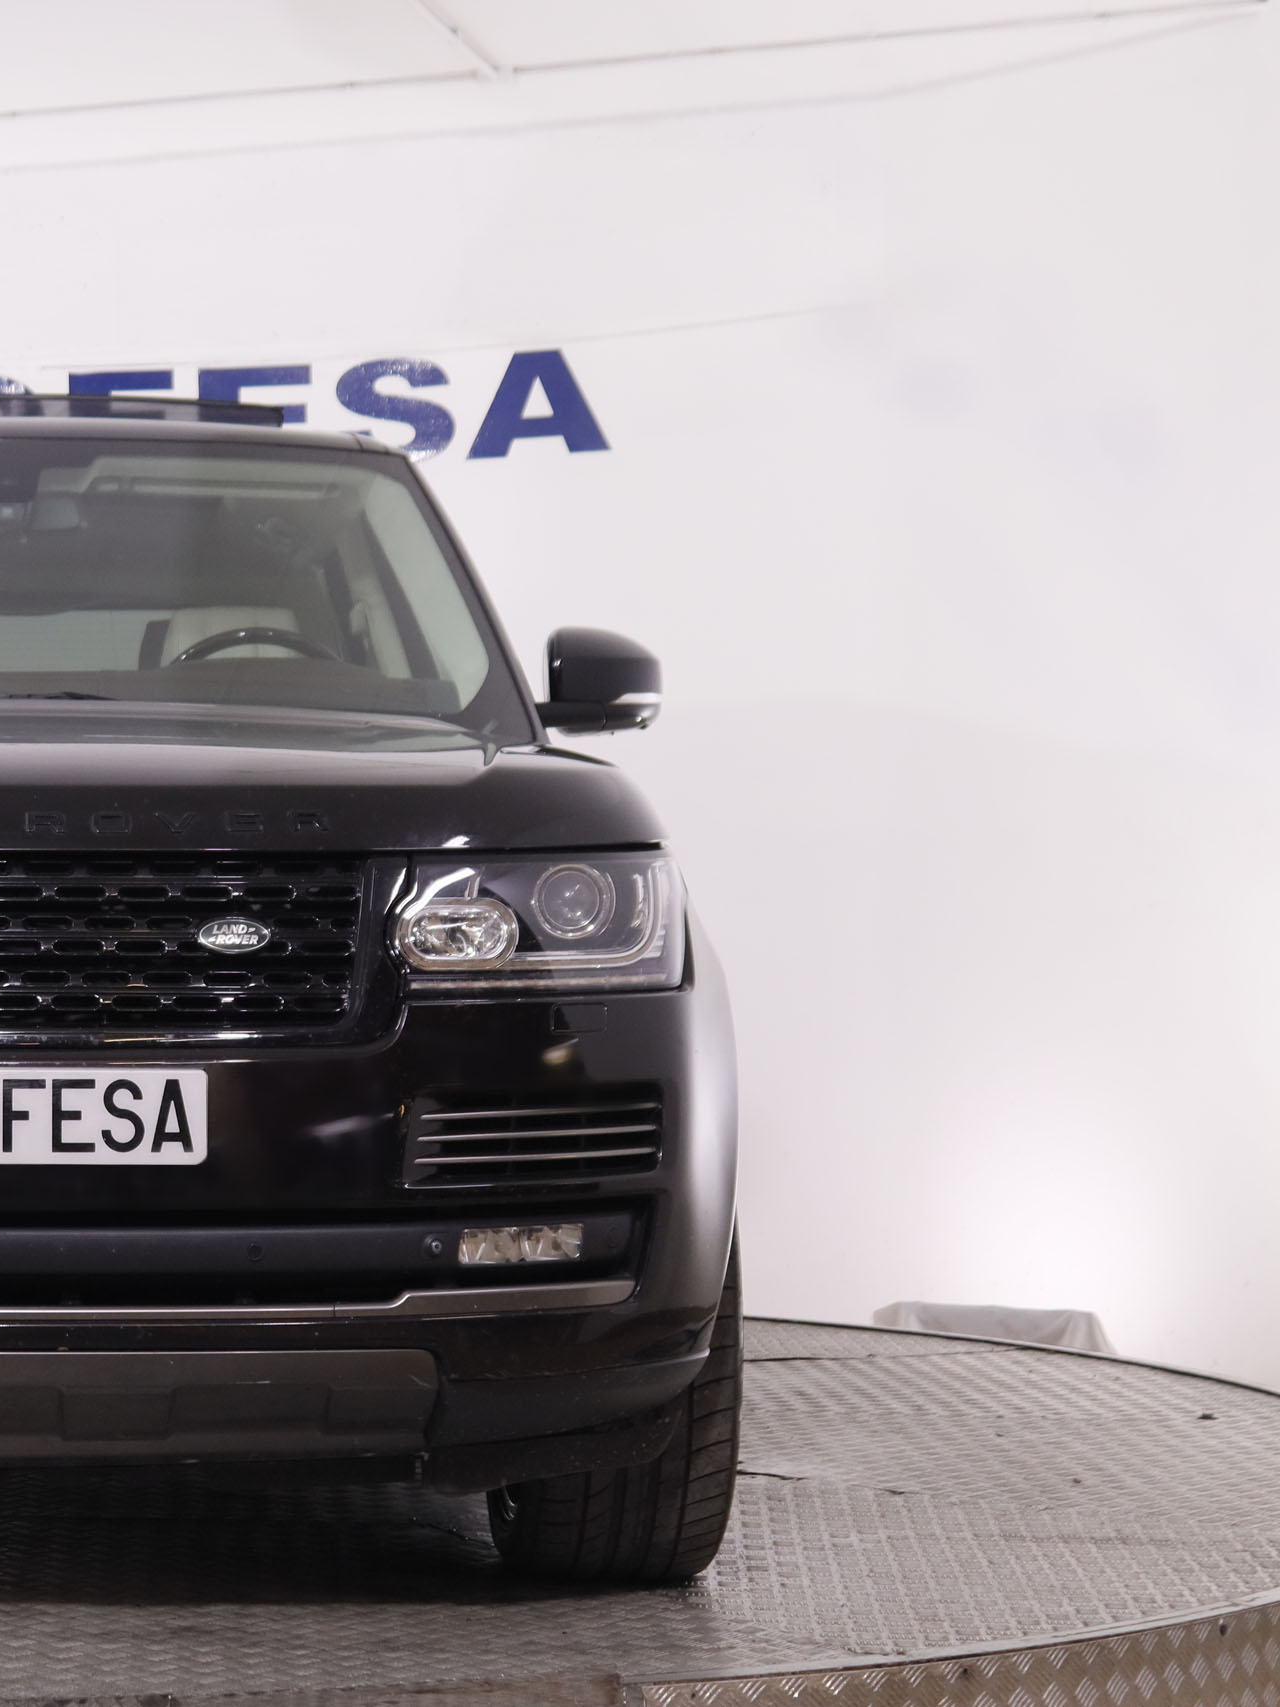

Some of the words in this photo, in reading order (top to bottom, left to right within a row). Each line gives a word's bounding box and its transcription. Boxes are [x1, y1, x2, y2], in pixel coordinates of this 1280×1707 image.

[23, 809, 330, 834] ROVER
[212, 924, 248, 934] LAND
[215, 934, 259, 945] ROVER
